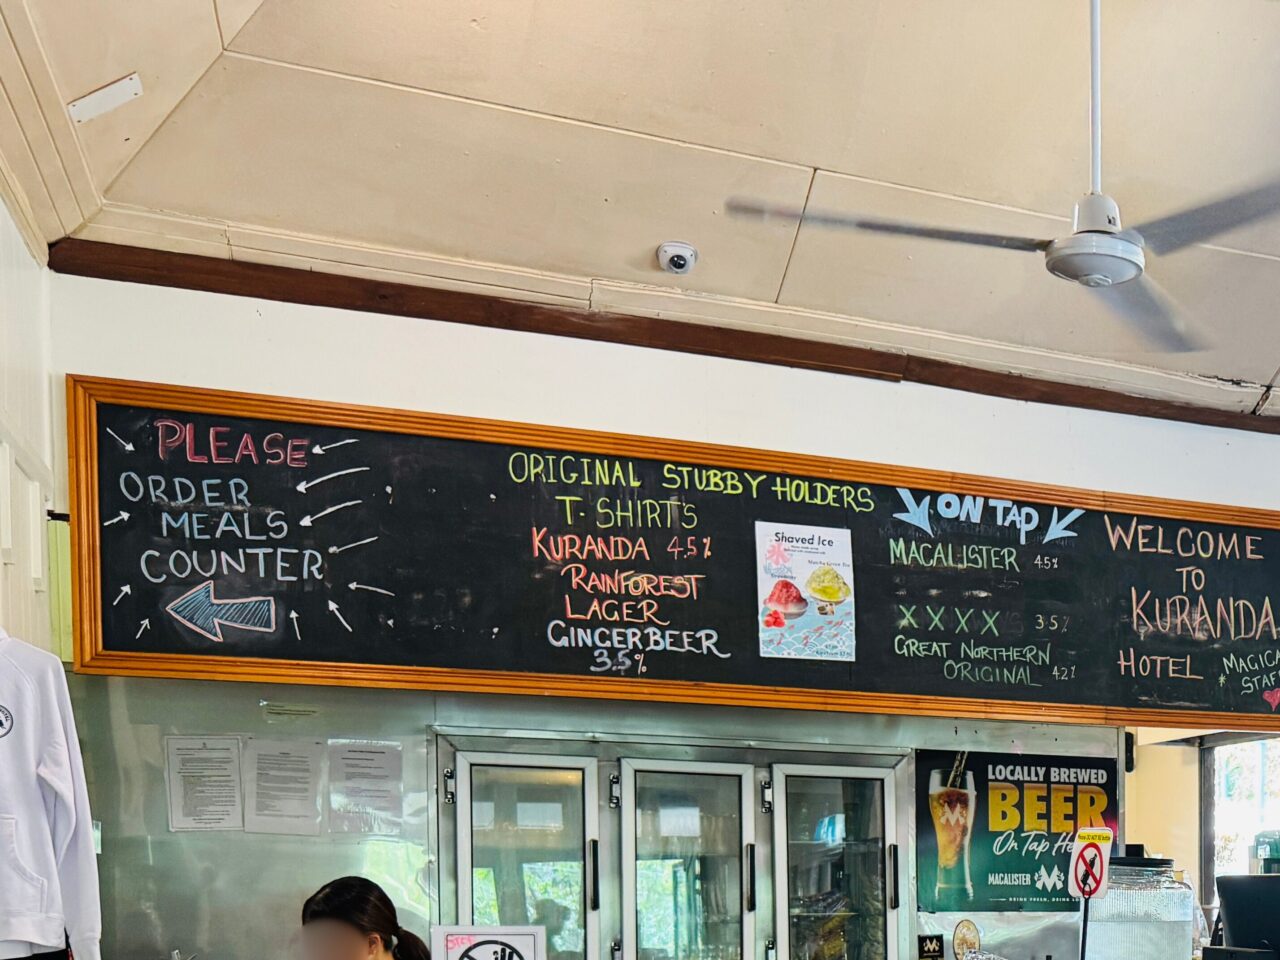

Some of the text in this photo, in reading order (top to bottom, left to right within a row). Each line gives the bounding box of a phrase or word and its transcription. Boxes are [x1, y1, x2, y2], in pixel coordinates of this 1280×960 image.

[153, 418, 311, 467] PLEASE
[119, 471, 252, 507] ORDER
[508, 452, 875, 513] ORIGINAL STUBBY HOLDERS
[160, 510, 289, 541] MEALS
[936, 493, 1040, 545] ON TAP
[532, 526, 650, 561] KURANDA
[774, 532, 834, 547] Shaved Ice
[1103, 514, 1264, 560] WELCOME
[140, 547, 324, 583] COUNTER
[889, 537, 1021, 573] MACALISTER
[561, 563, 706, 601] RAINFOREST
[1176, 566, 1205, 593] TO
[565, 595, 671, 627] LAGER
[1131, 586, 1278, 641] KURANDA
[894, 635, 1051, 666] GREAT NORTHERN
[1118, 648, 1204, 680] HOTEL
[943, 659, 1043, 687] ORIGINAL
[987, 764, 1108, 784] LOCALLY BREWED
[988, 781, 1108, 834] BEER
[993, 830, 1019, 856] On
[1020, 831, 1050, 860] Tap
[988, 872, 1031, 886] MACALISTER
